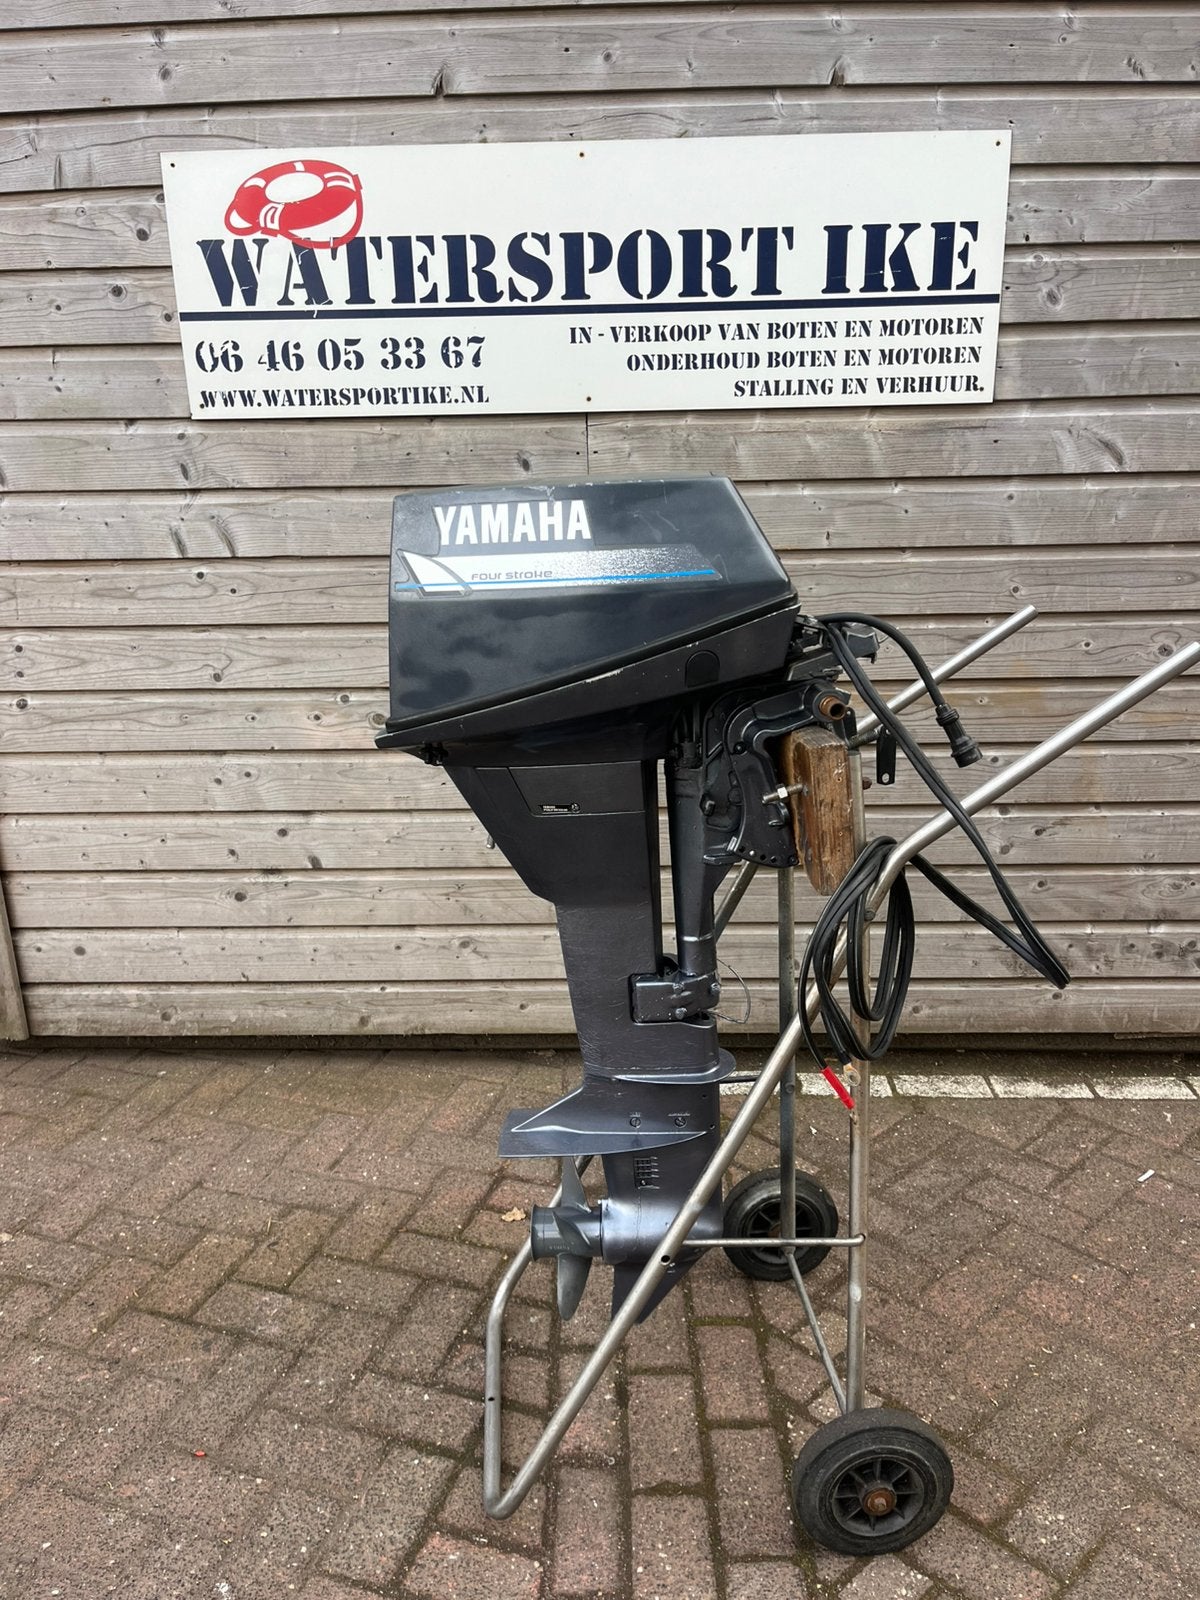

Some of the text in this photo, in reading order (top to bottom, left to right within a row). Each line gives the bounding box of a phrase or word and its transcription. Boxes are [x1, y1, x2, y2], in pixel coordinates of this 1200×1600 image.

[196, 221, 979, 308] WATERSPORT IKE
[569, 326, 592, 344] IN
[610, 324, 712, 343] VERKOOP
[718, 322, 760, 341] VAN
[767, 321, 838, 340] BOTEN
[844, 320, 873, 338] EN
[879, 316, 984, 337] MOTOREN
[195, 335, 486, 373] 06 46 05 33 67
[626, 346, 982, 371] ONDERHOUD BOTEN EN MOTOREN
[734, 378, 834, 397] STALLING
[842, 377, 869, 395] EN
[433, 500, 592, 546] YAMAHA
